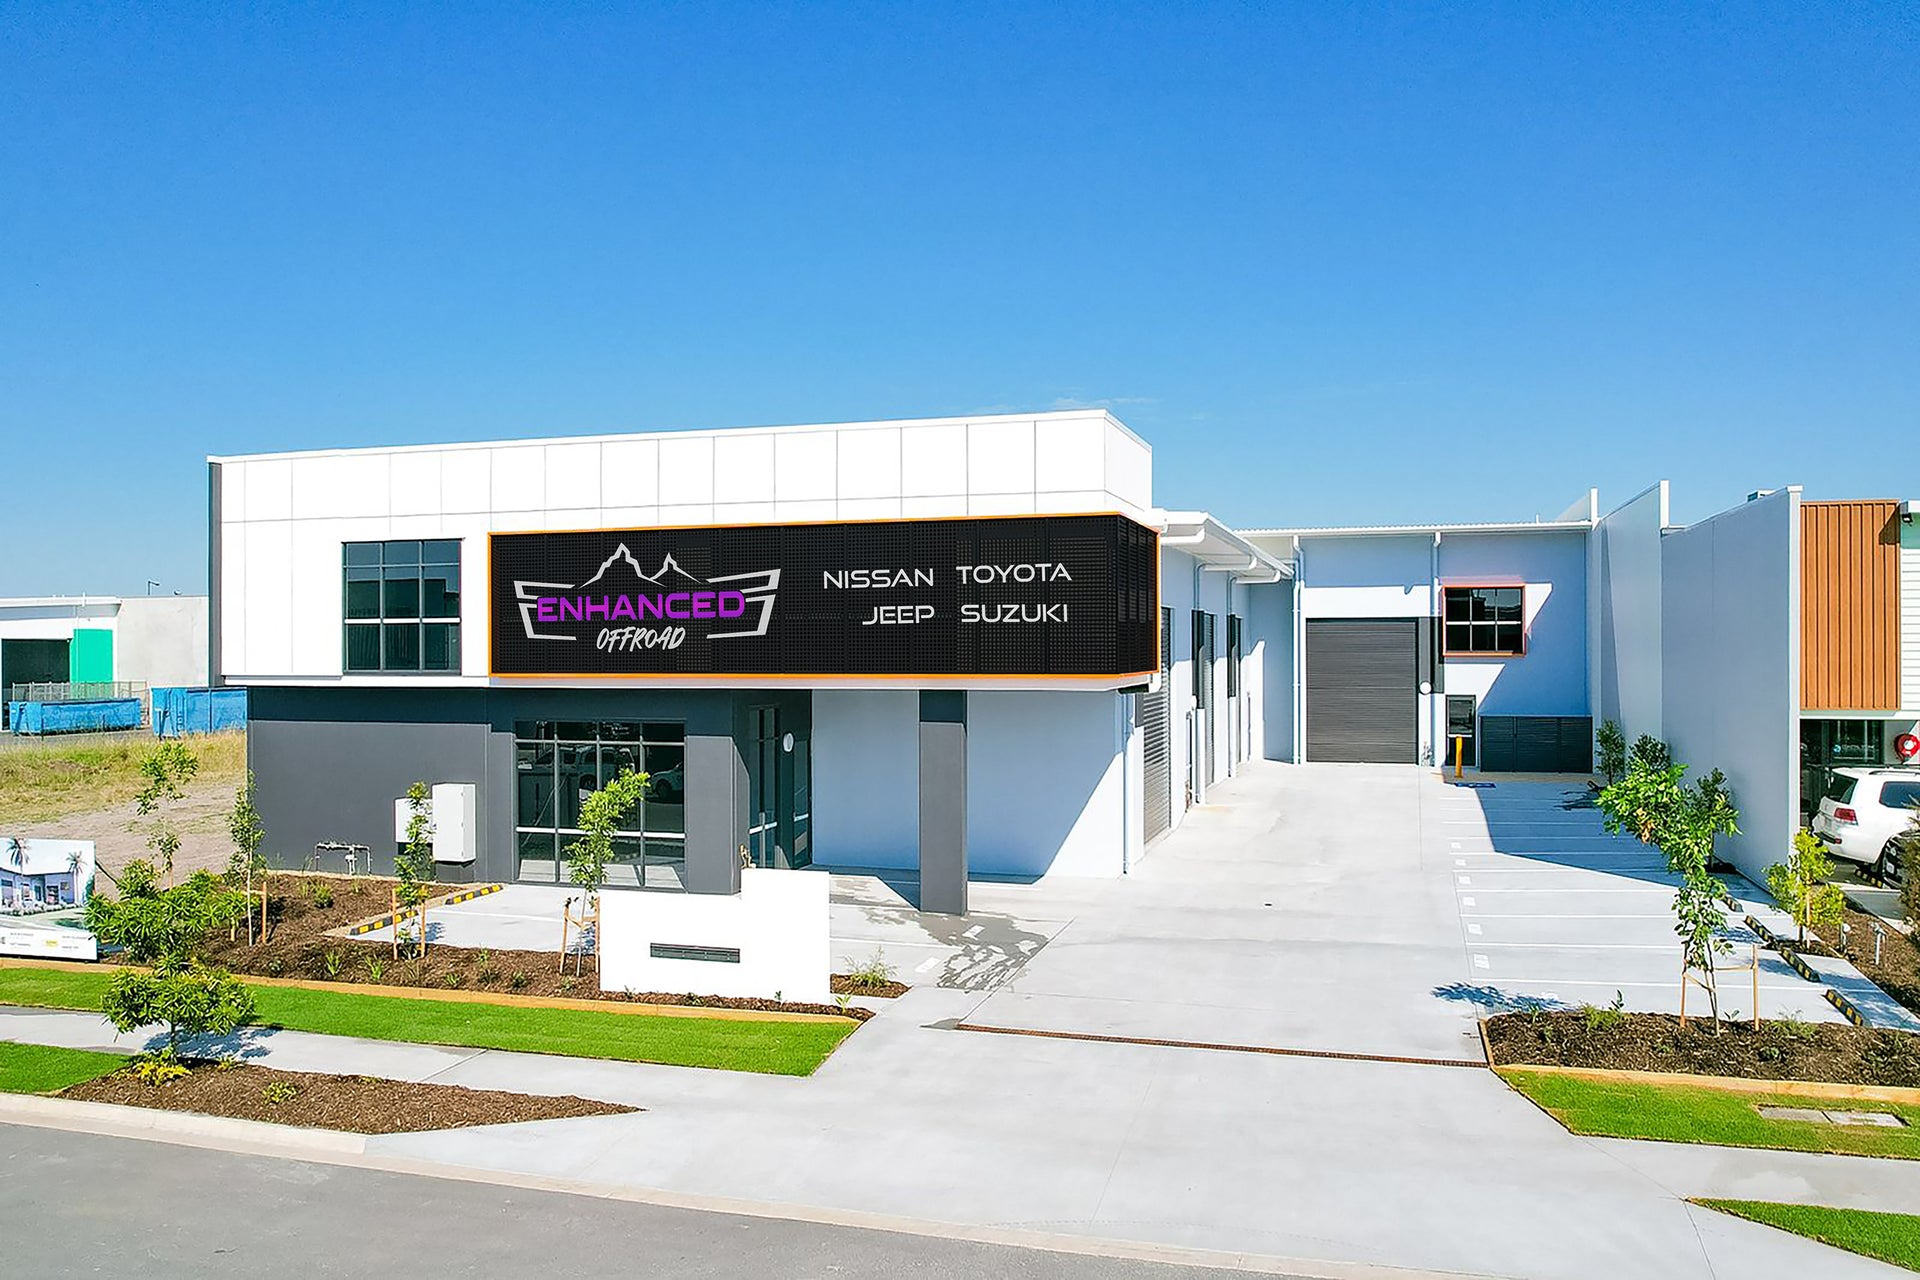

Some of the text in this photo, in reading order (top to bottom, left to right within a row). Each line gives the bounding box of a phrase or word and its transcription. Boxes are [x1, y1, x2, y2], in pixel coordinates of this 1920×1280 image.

[823, 562, 1073, 590] NISSAN TOYOTA
[537, 590, 745, 622] ENHANCED
[862, 603, 1068, 626] JEEP SUZUKI
[596, 625, 686, 652] OFFROAD
